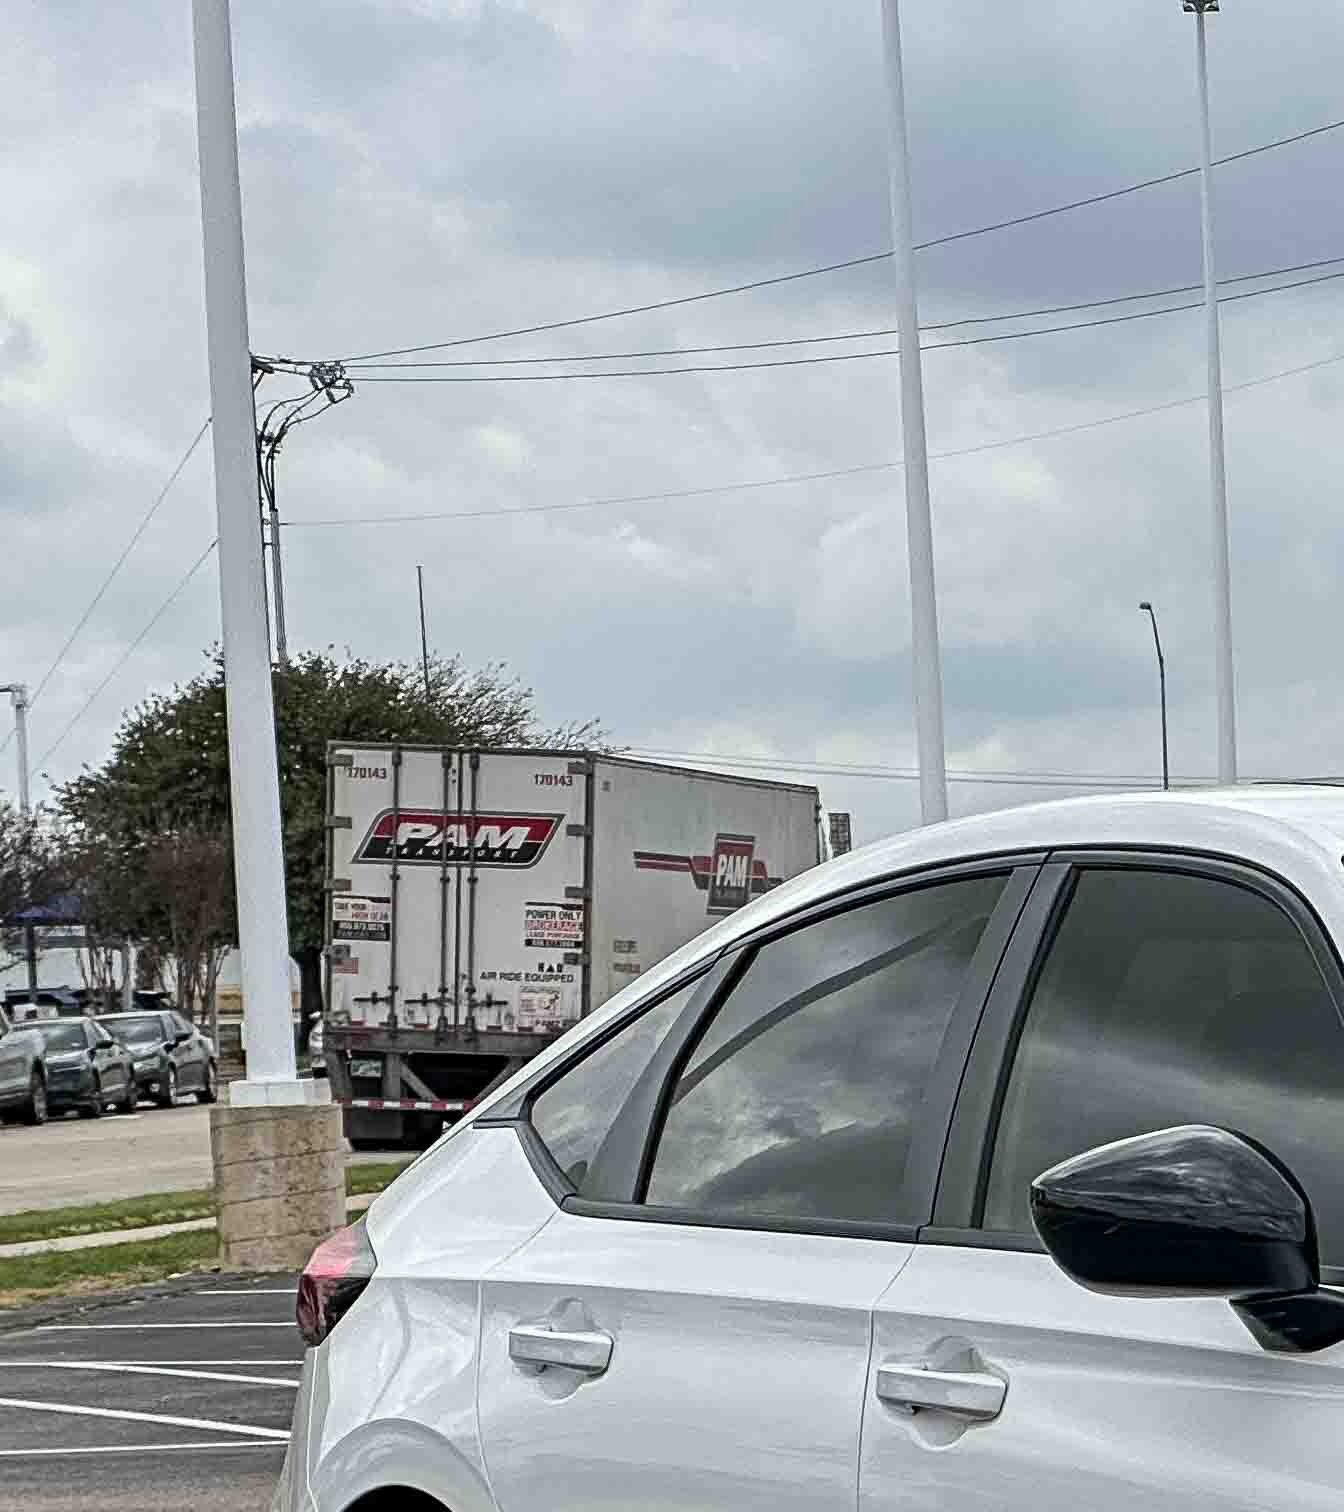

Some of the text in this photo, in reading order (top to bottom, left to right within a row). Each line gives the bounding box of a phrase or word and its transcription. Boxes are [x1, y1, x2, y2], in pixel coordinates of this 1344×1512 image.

[391, 822, 532, 850] PAM
[715, 854, 749, 888] PAM
[559, 910, 582, 921] ONLY
[524, 972, 574, 984] EQUIPPED
